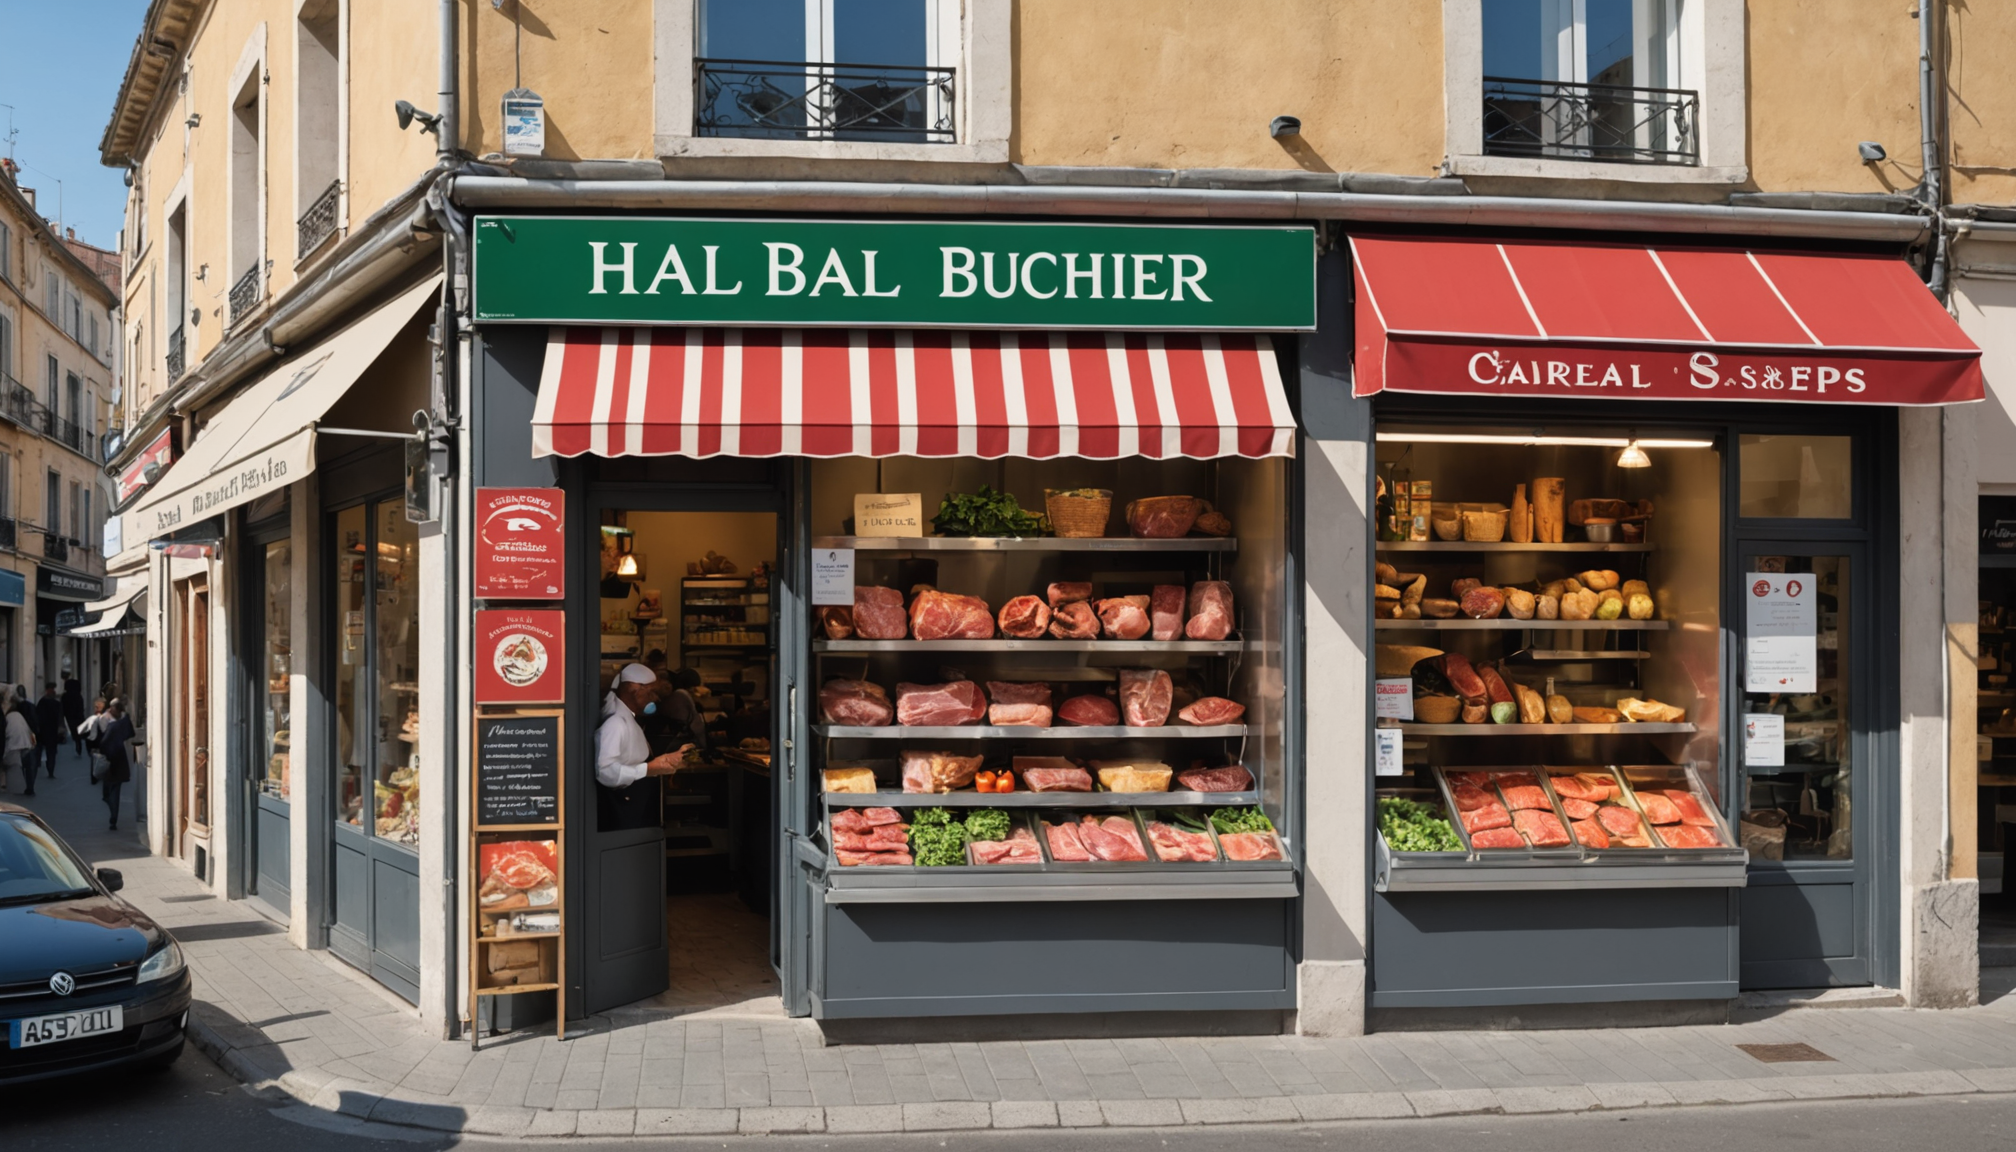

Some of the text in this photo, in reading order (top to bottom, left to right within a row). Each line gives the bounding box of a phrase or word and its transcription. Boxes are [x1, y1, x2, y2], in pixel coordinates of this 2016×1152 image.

[587, 241, 1214, 302] HAL BAL BUCHIER
